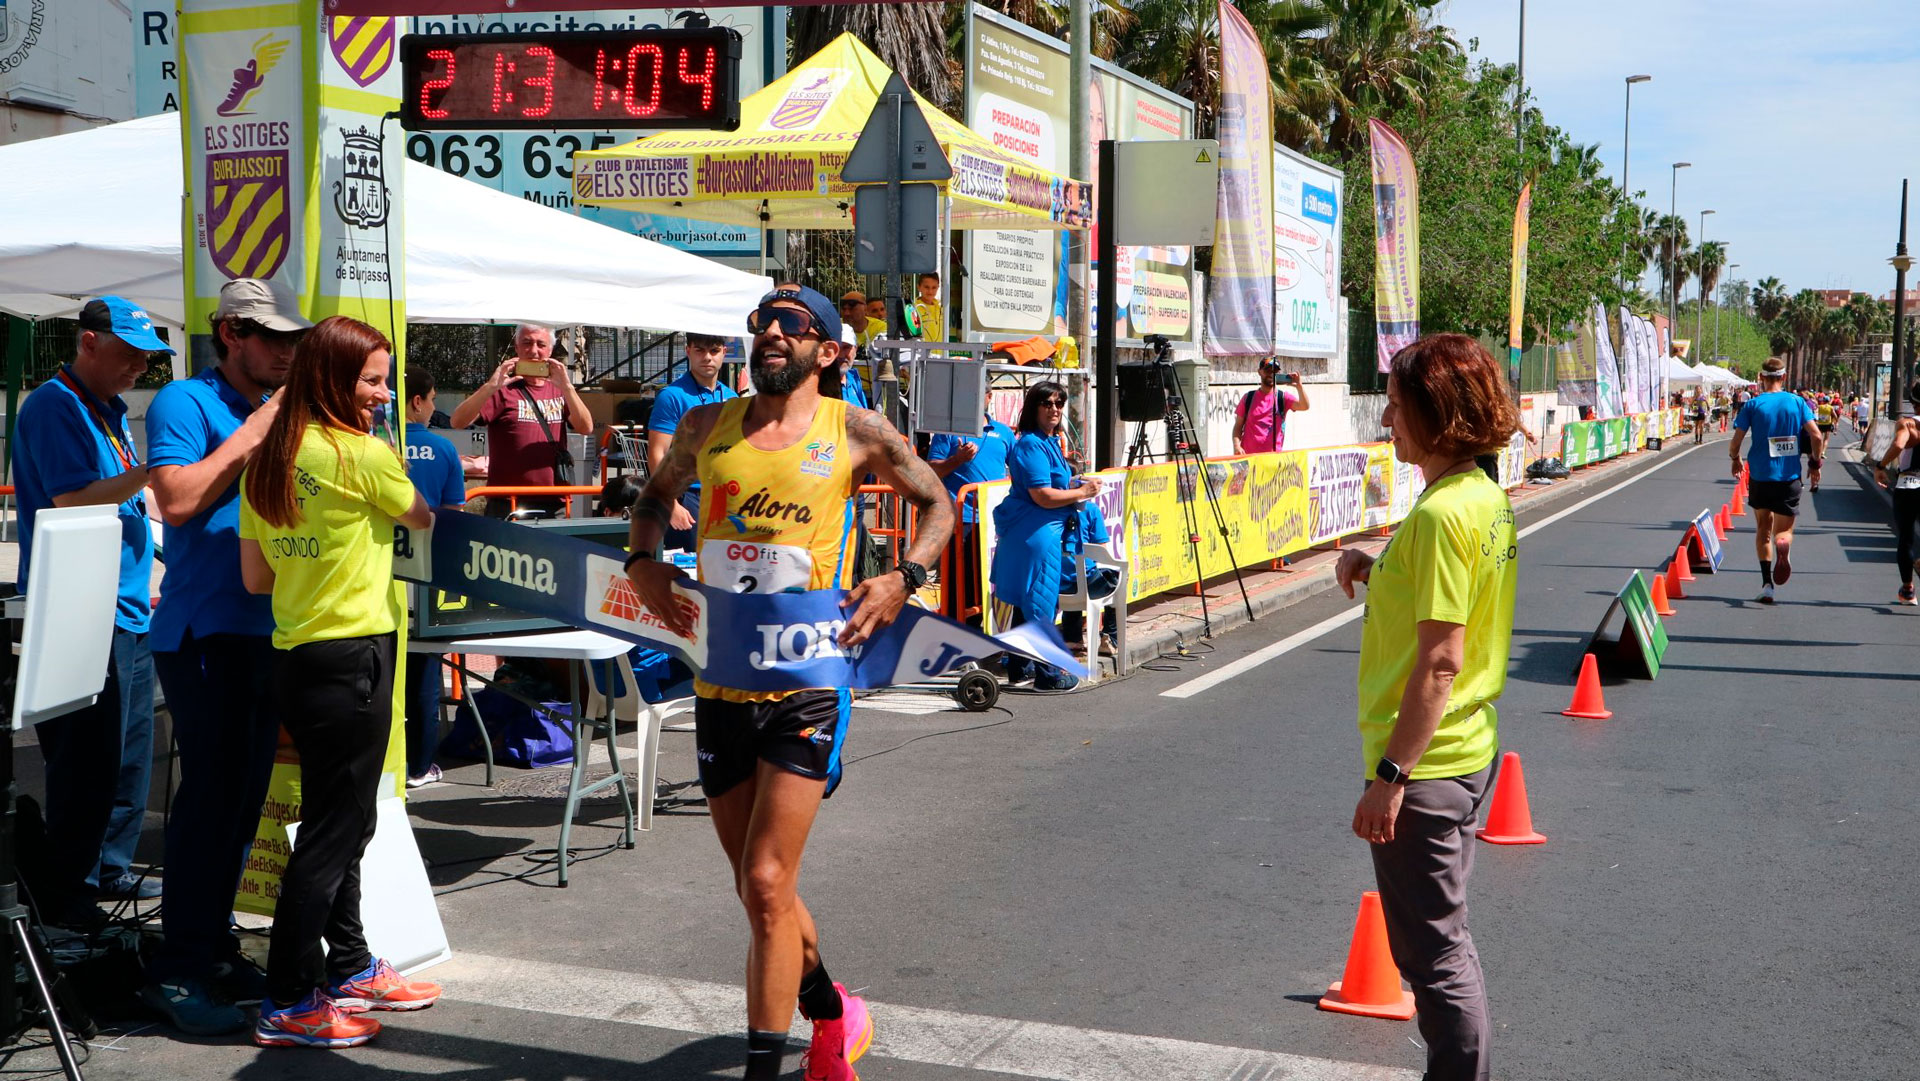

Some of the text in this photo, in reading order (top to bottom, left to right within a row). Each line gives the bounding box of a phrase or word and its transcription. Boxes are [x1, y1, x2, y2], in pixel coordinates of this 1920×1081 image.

[992, 109, 1041, 136] PREPARACIÓN
[204, 121, 289, 151] ELS SITGES
[993, 132, 1039, 157] OPOSICIONES
[213, 156, 283, 181] BURJASSOT
[595, 157, 688, 172] CLUB D'ATLETISME
[697, 152, 814, 197] #BurjassotEsAtletismo
[594, 172, 689, 197] ELS SITGES
[336, 246, 388, 264] Ajuntamen
[335, 265, 390, 285] de Burjasso
[472, 433, 485, 443] 15
[1776, 442, 1794, 452] 2413
[294, 466, 322, 497] TGES
[737, 487, 814, 524] Álora
[463, 540, 558, 596] Joma
